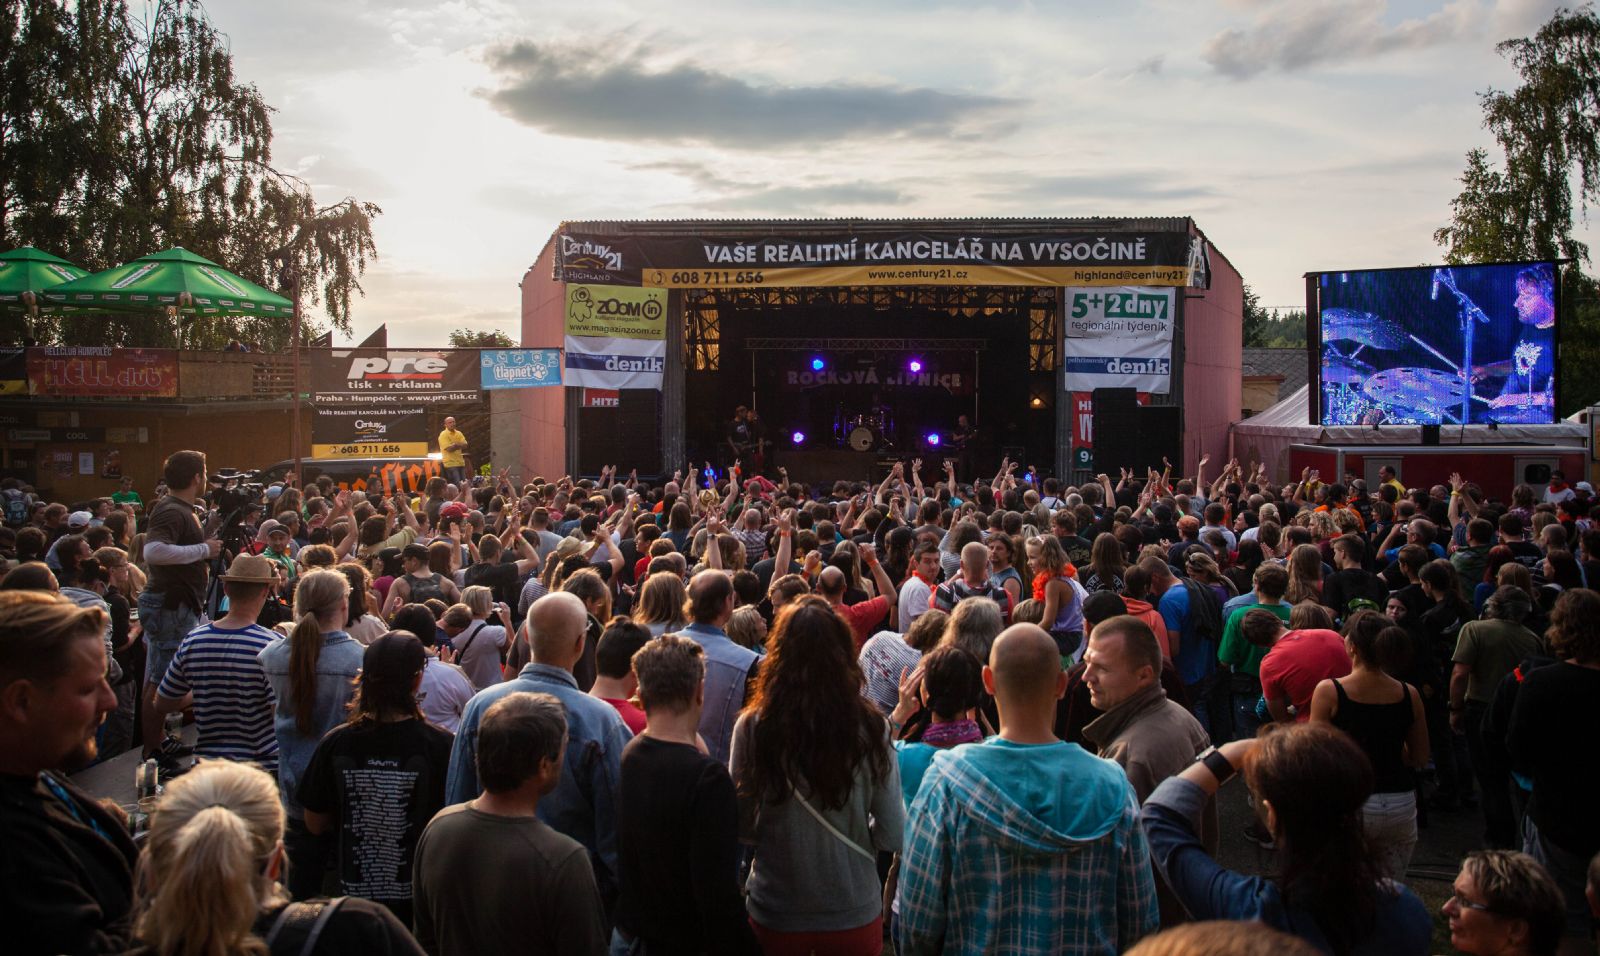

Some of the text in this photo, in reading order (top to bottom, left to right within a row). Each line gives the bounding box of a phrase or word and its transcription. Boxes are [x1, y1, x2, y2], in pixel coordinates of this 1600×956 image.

[704, 237, 1146, 263] VAŠE REALITNÍ KANCELÁŘ NA VYSOČINĚ
[605, 252, 622, 271] 21
[671, 271, 764, 284] 608 711 656
[868, 268, 968, 280] www.century21.cz
[569, 323, 662, 335] www.magazinzoom.cz
[1071, 321, 1168, 332] regionální týdeník
[346, 357, 448, 379] pre
[605, 356, 663, 372] deník
[1107, 358, 1169, 375] deník
[495, 364, 532, 380] tlapnet
[348, 381, 442, 389] tisk reklama
[407, 393, 477, 402] www.pre-tisk.cz
[66, 432, 89, 440] COOL
[341, 446, 359, 454] 608
[382, 445, 400, 453] 656
